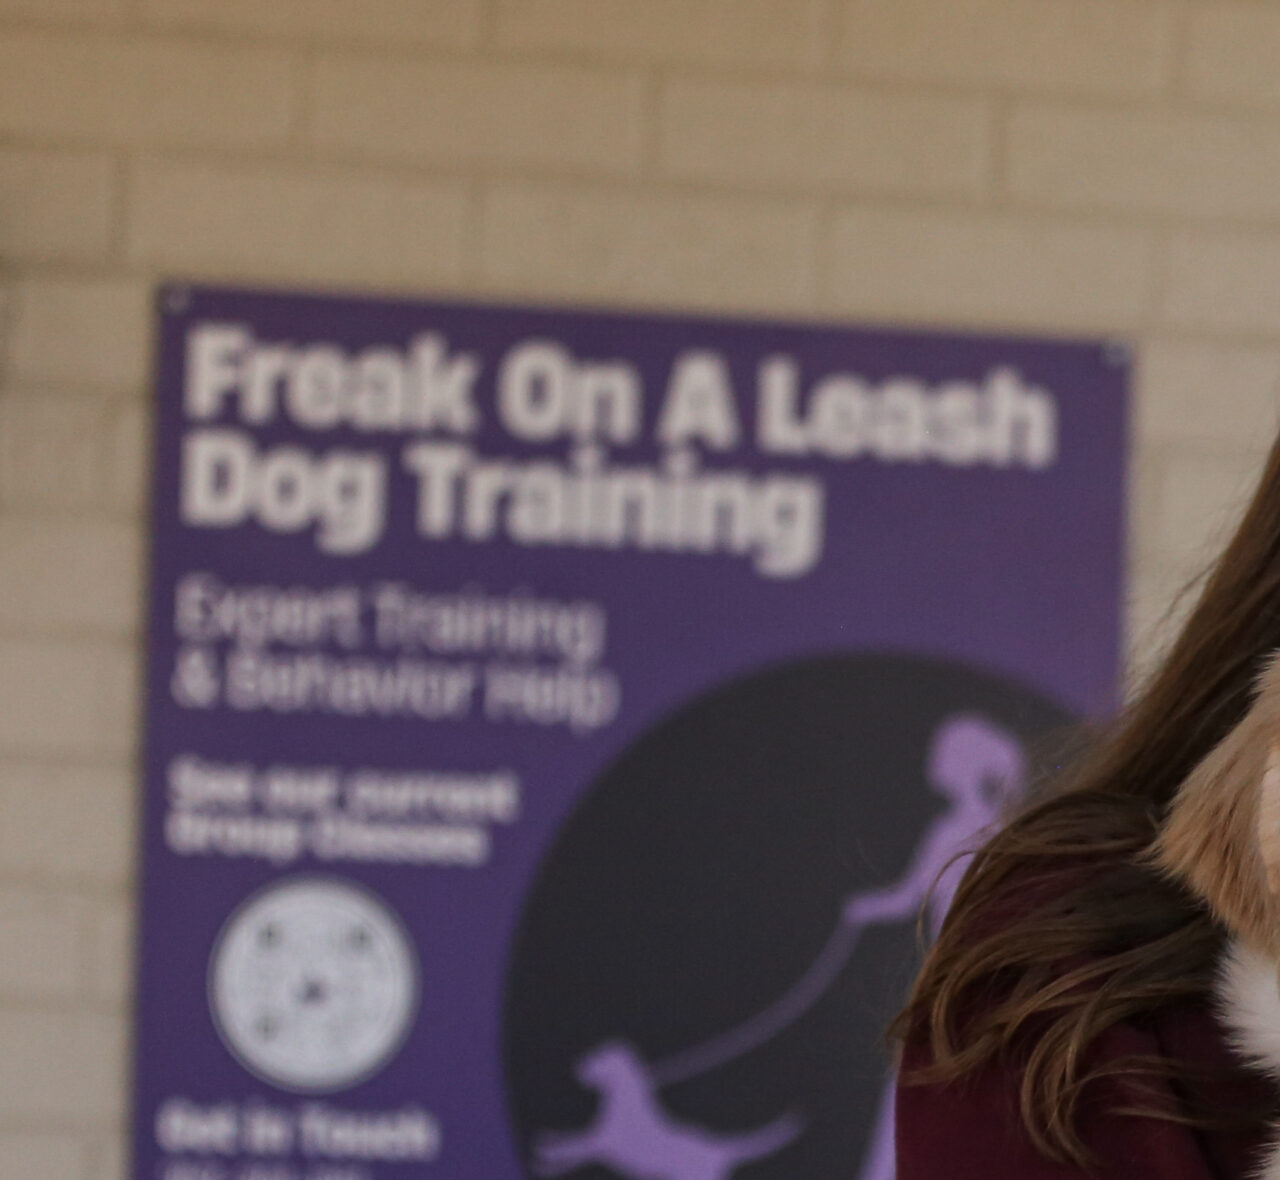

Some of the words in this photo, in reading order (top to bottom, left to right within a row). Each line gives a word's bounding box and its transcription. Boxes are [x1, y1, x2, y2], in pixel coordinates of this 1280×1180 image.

[184, 326, 476, 434] Freak
[496, 343, 638, 444] On
[658, 352, 738, 450] A
[758, 358, 1056, 468] Leash
[181, 434, 388, 556] Dog
[406, 444, 821, 580] Training
[175, 577, 362, 650] Expert
[375, 582, 607, 662] Training
[172, 646, 219, 710] &
[226, 650, 472, 714] Behavior
[484, 656, 620, 730] Help
